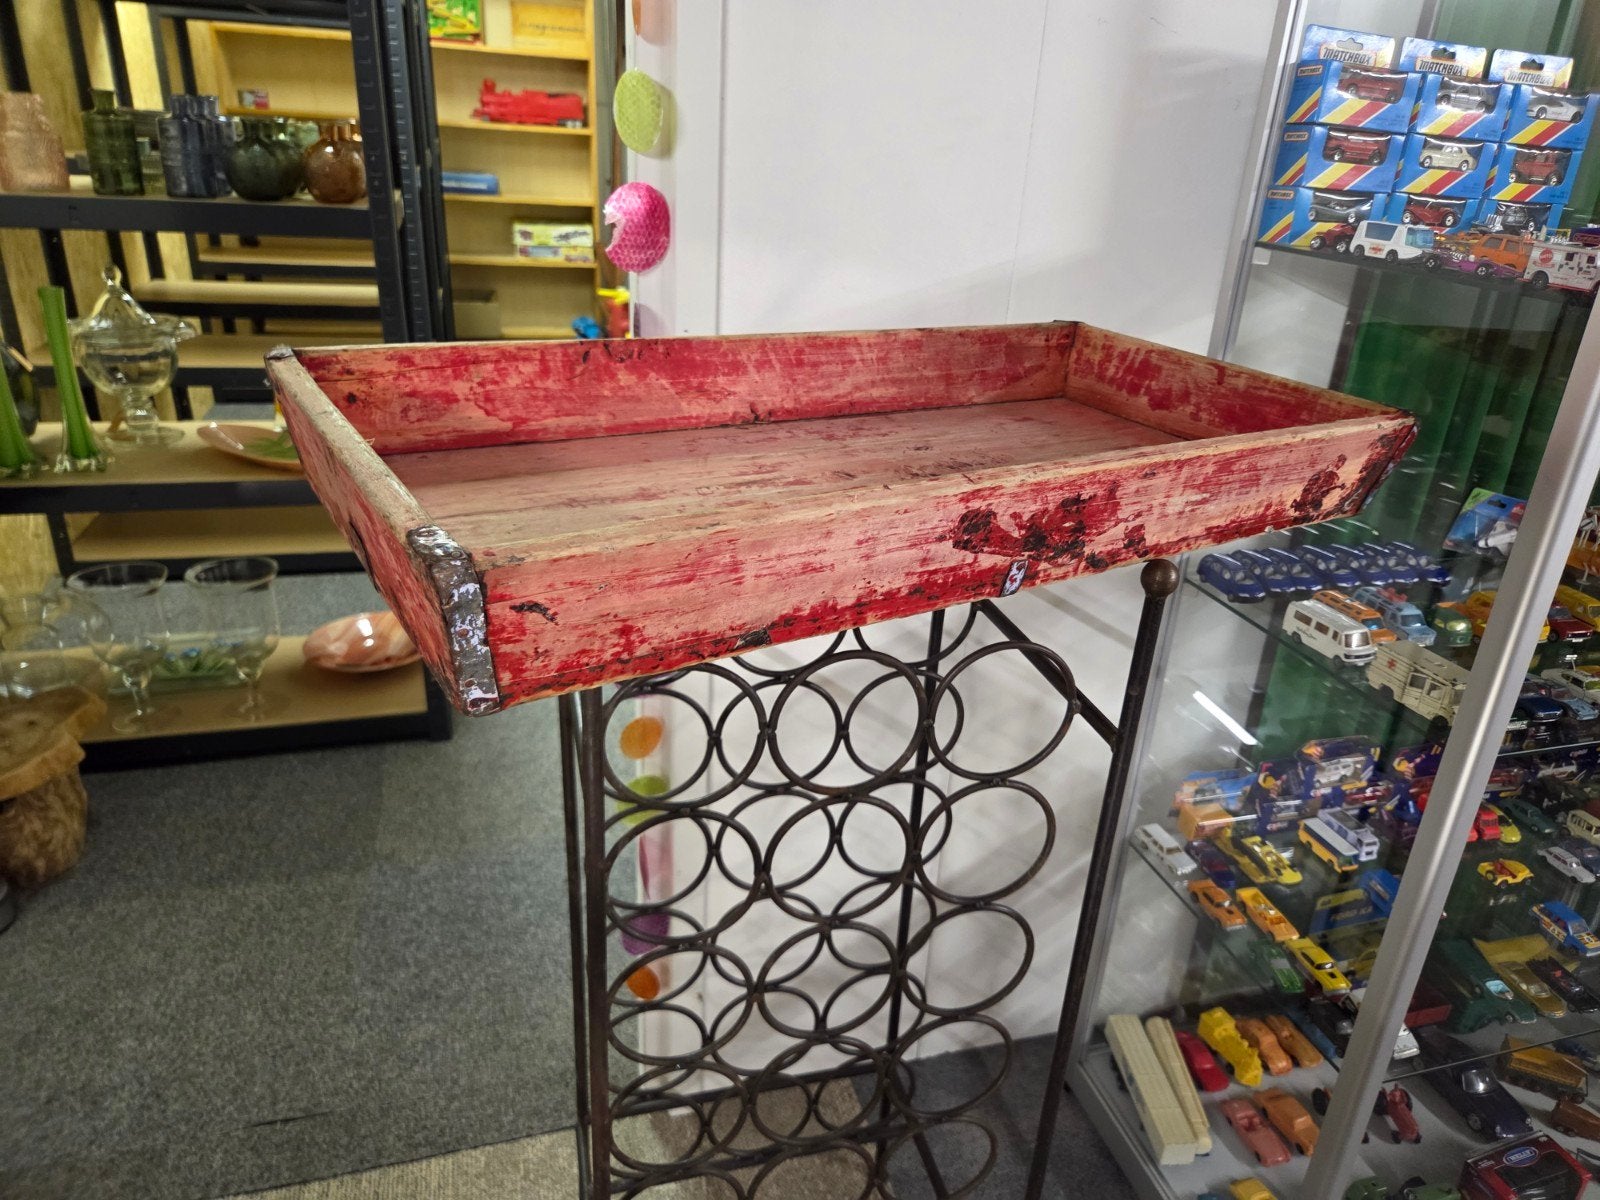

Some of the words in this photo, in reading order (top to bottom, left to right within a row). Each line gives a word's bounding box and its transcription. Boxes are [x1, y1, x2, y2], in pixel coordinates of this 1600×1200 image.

[1323, 47, 1372, 65] MATCHBOX
[1418, 60, 1463, 76] MATCHBOX
[1507, 71, 1553, 85] MATCHBOX
